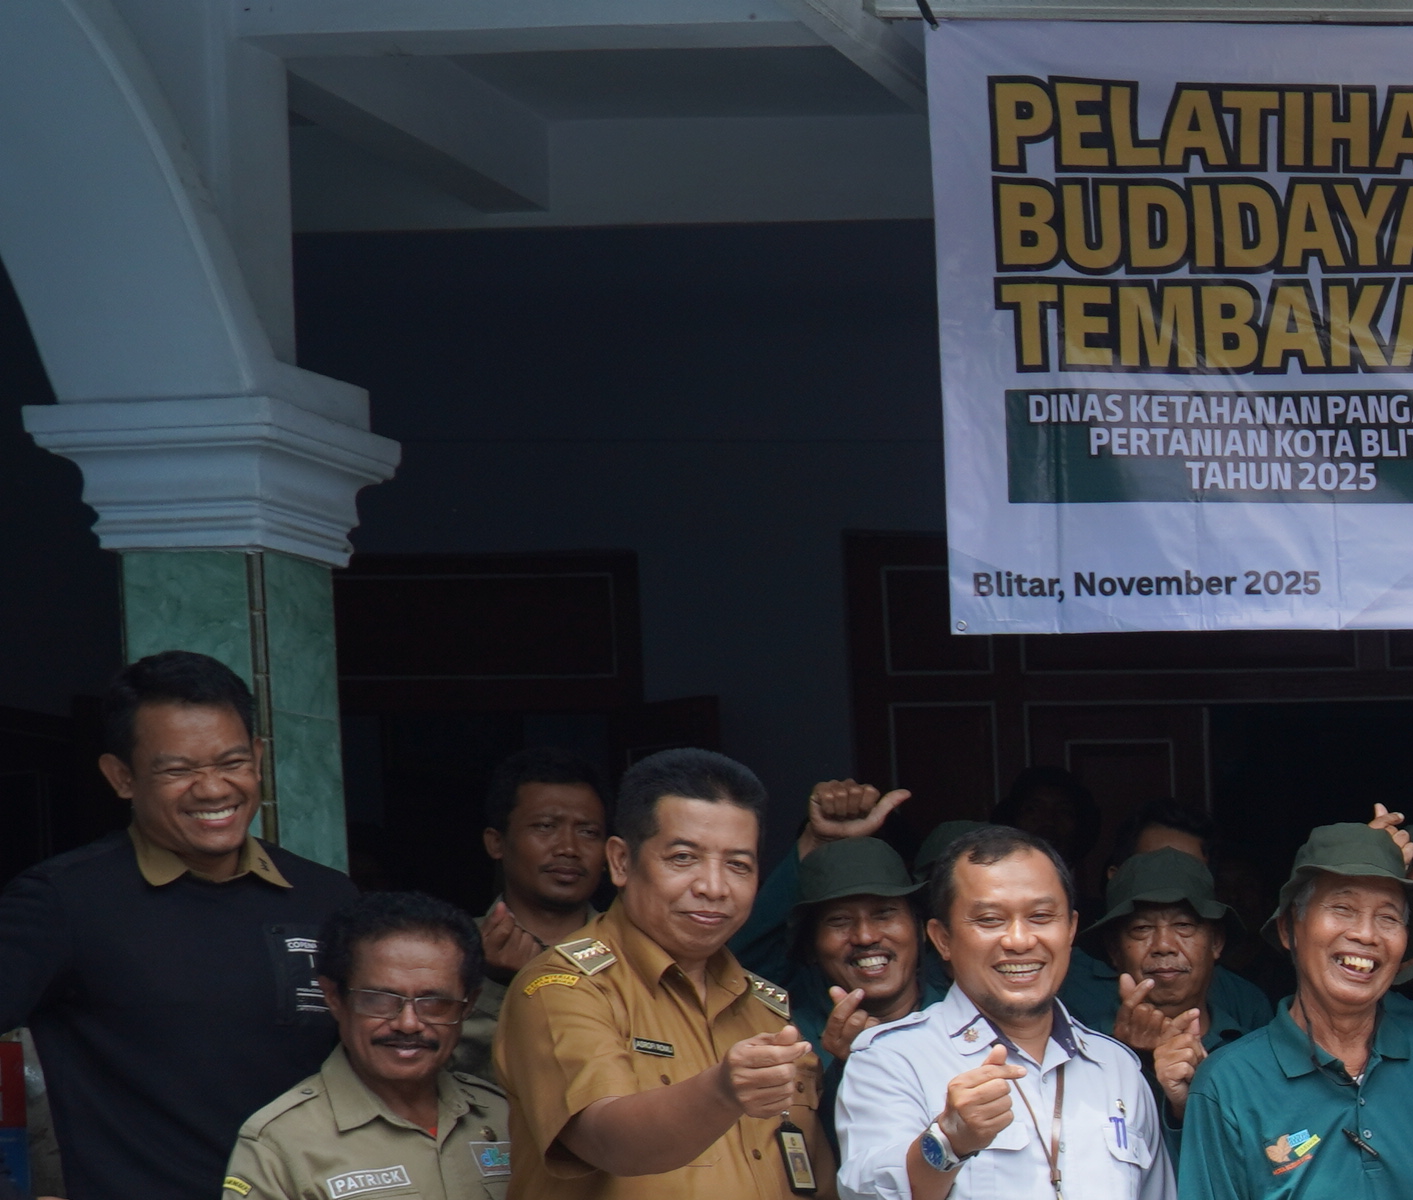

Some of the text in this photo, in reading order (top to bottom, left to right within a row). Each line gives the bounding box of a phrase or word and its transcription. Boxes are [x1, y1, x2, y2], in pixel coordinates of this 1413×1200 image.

[1028, 394, 1125, 426] DINAS
[1128, 394, 1323, 426] KETAHANAN
[1089, 428, 1270, 458] PERTANIAN
[1275, 429, 1356, 459] KOTA
[1187, 461, 1377, 492] TAHUN 2025
[971, 569, 1322, 603] Blitar, November 2025
[334, 1170, 402, 1193] PATRICK
